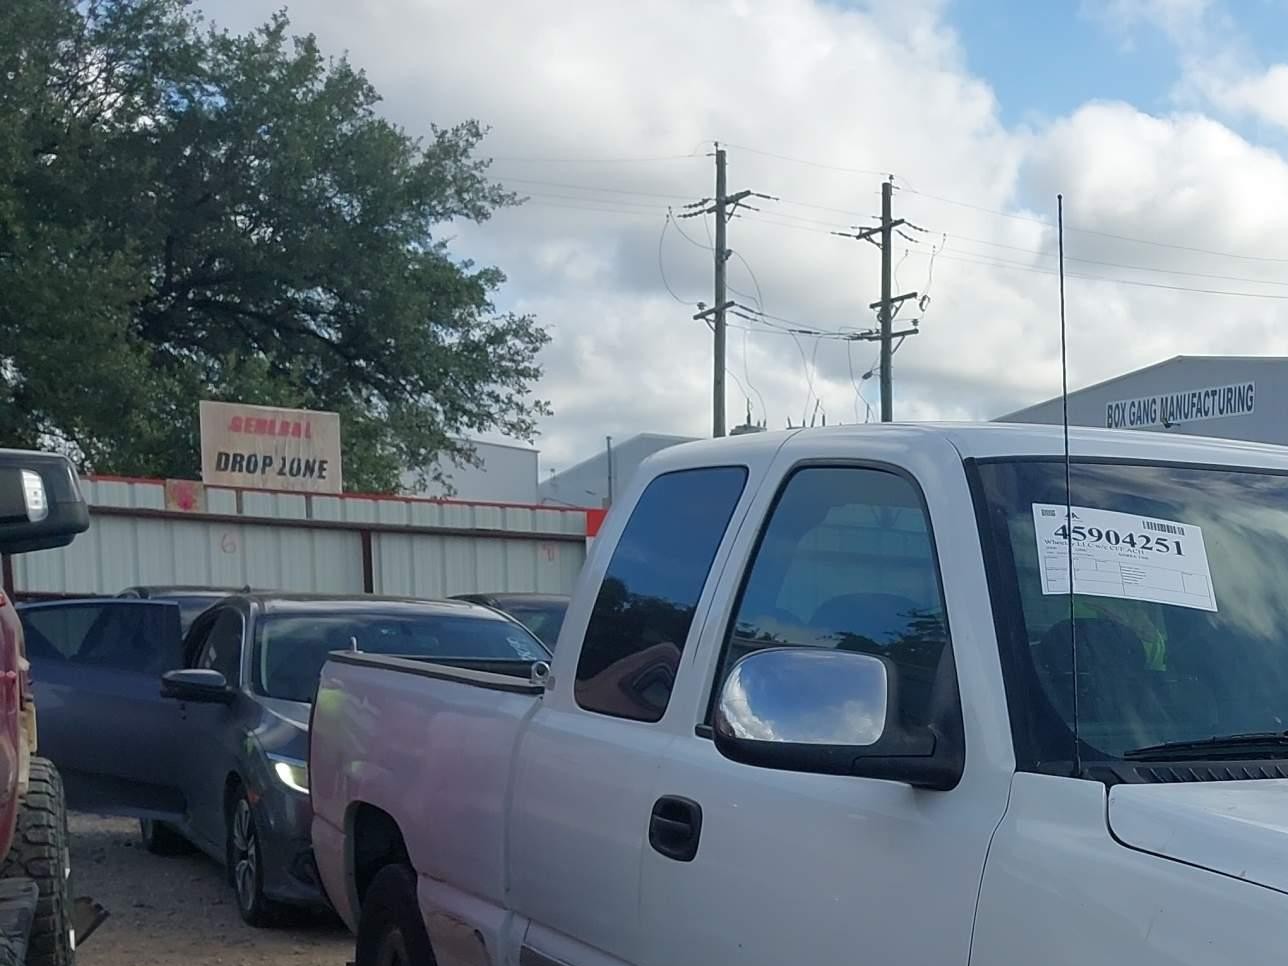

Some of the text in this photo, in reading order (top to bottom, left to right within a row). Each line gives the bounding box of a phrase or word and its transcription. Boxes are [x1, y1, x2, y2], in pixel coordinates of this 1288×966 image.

[1107, 384, 1254, 428] BOX GANG MANUFACTURING
[215, 451, 329, 480] DROP ZONE
[1054, 523, 1185, 557] 45904251
